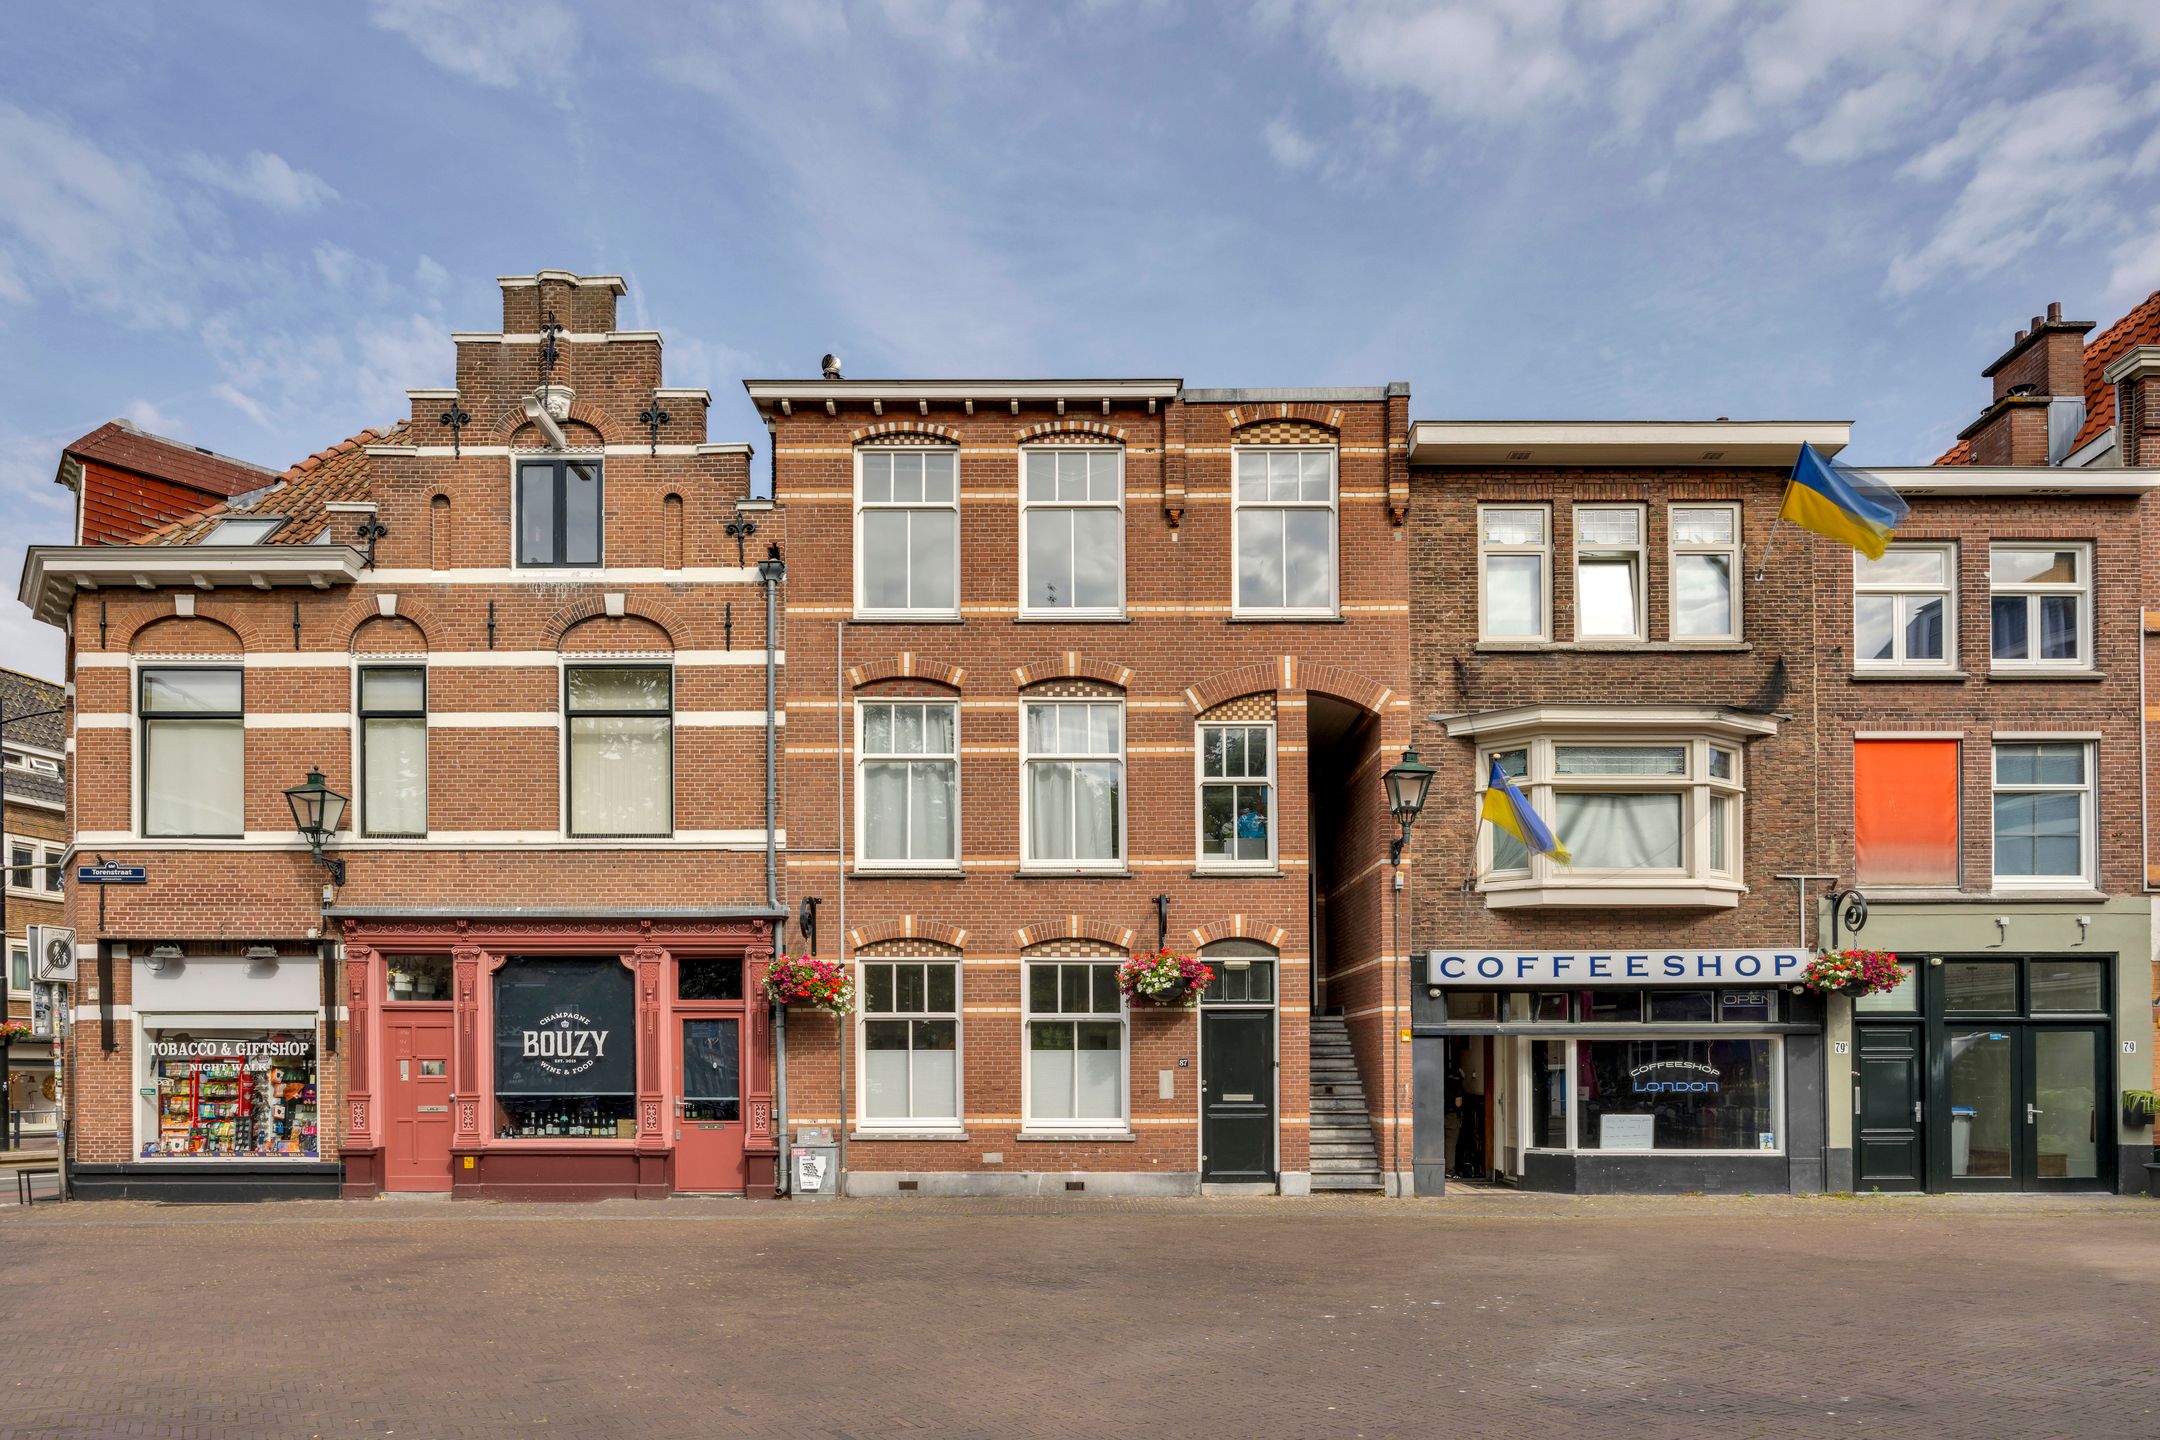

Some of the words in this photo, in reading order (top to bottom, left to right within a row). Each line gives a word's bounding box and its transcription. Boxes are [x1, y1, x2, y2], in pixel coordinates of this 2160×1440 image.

[1440, 954, 1797, 979] COFFEESHOP
[540, 1012, 591, 1026] CHAMPAGNE
[148, 1042, 217, 1056] TOBACCO
[220, 1042, 232, 1056] &
[235, 1042, 309, 1056] GIFTSHOP
[522, 1030, 609, 1057] BOUZY
[2124, 1042, 2135, 1053] 79
[189, 1063, 228, 1072] NIGHT
[230, 1063, 268, 1072] WALK
[540, 1060, 562, 1075] WINE
[572, 1060, 594, 1074] FOOD
[1630, 1061, 1720, 1077] COFFEESHOP
